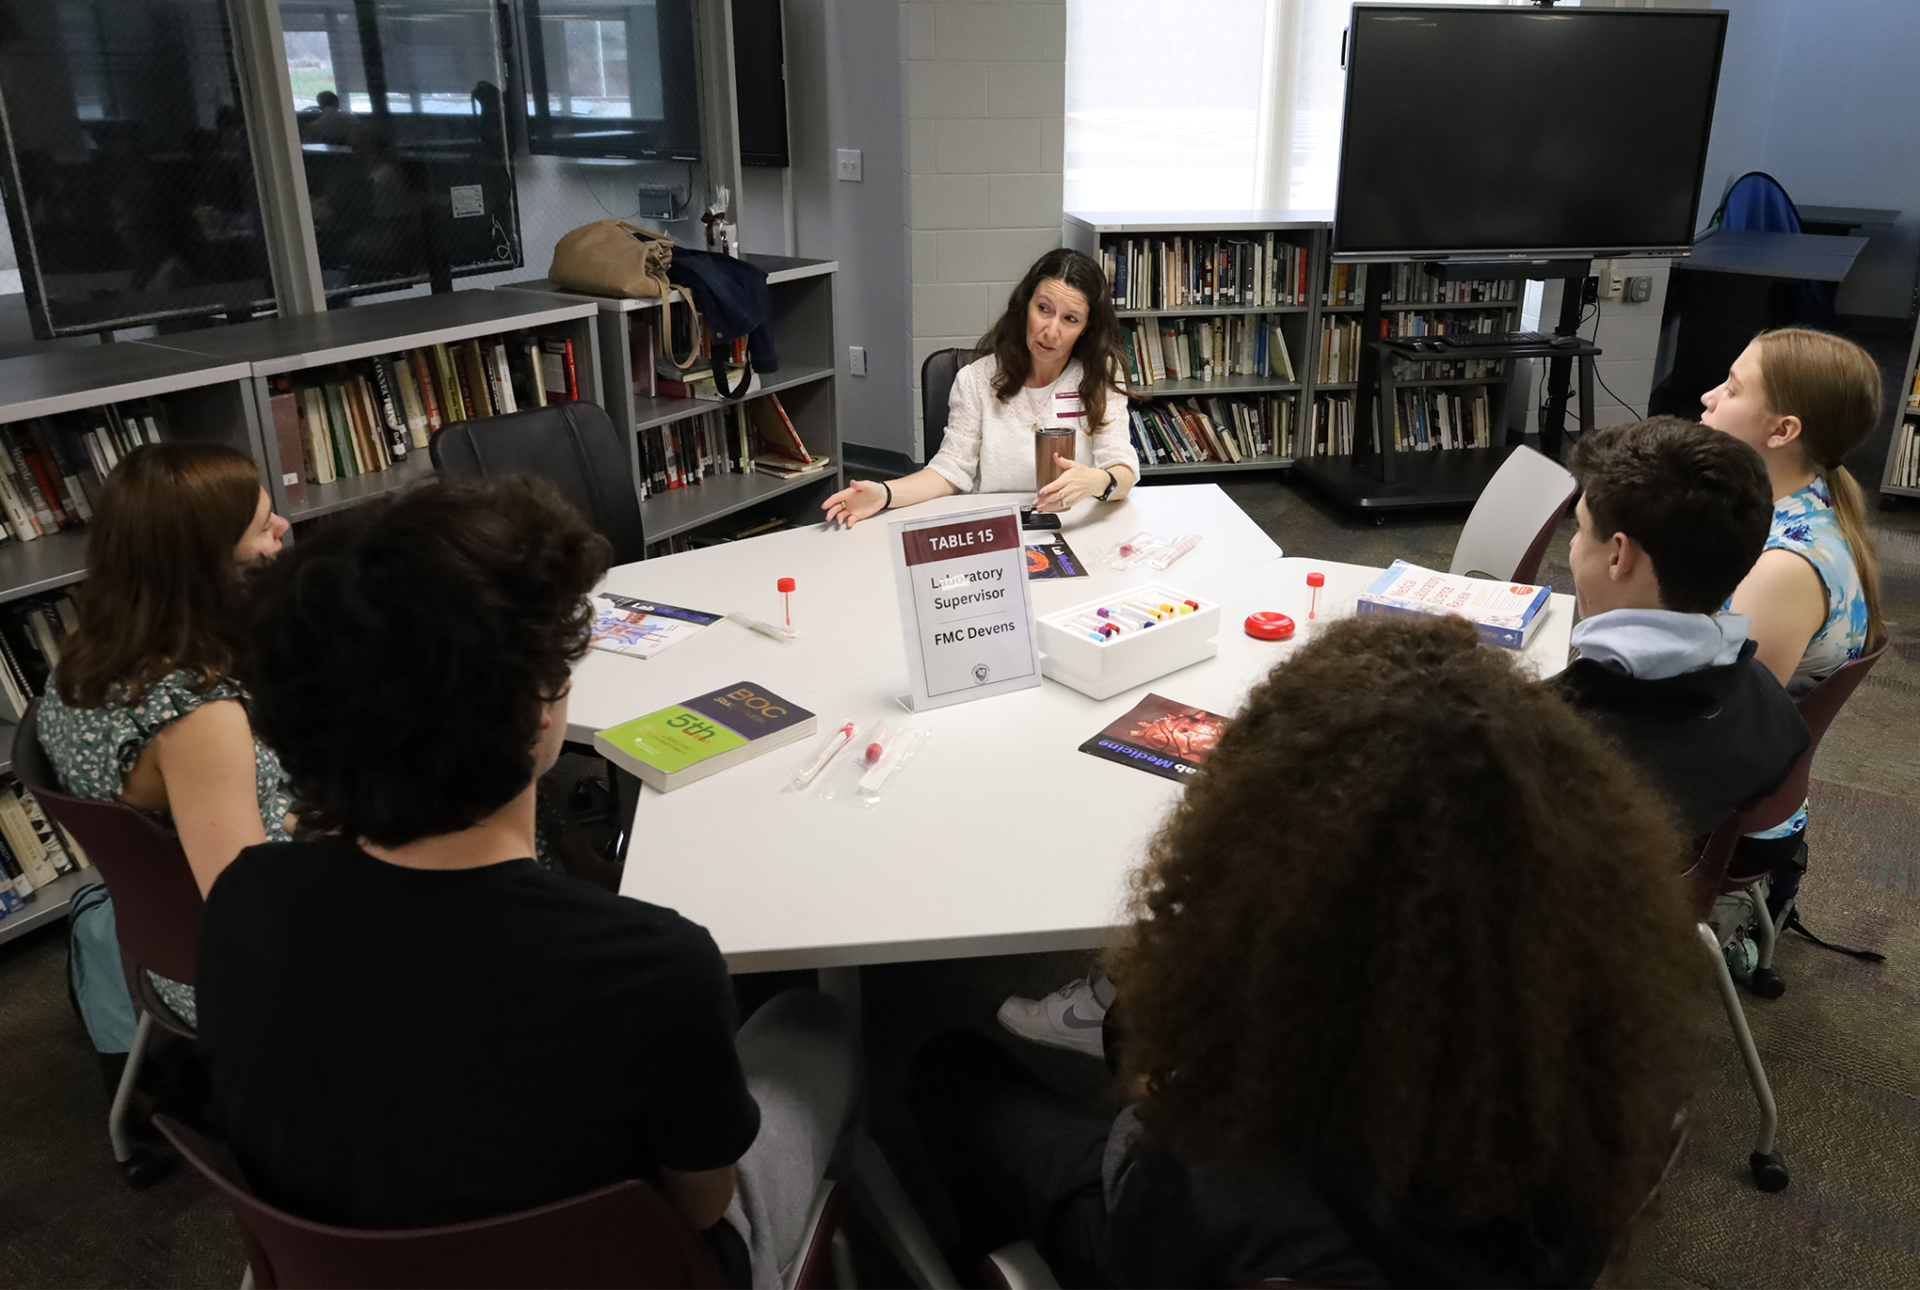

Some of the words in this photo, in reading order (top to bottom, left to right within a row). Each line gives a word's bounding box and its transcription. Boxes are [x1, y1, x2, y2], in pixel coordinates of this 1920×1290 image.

[929, 532, 974, 551] TABLE
[978, 529, 994, 543] 15
[931, 567, 1003, 590] Laboratory
[1391, 578, 1417, 598] Medical
[1409, 576, 1445, 600] Laboratory
[934, 587, 1005, 610] Supervisor
[1427, 586, 1454, 605] Science
[1446, 591, 1472, 609] Review
[631, 602, 655, 612] Lab
[655, 607, 710, 621] Medicine
[934, 628, 965, 646] FMC
[968, 621, 1015, 639] Devens
[728, 689, 787, 718] BOC
[667, 713, 715, 740] 5th
[1098, 740, 1174, 769] Medicine
[1175, 763, 1197, 775] ab
